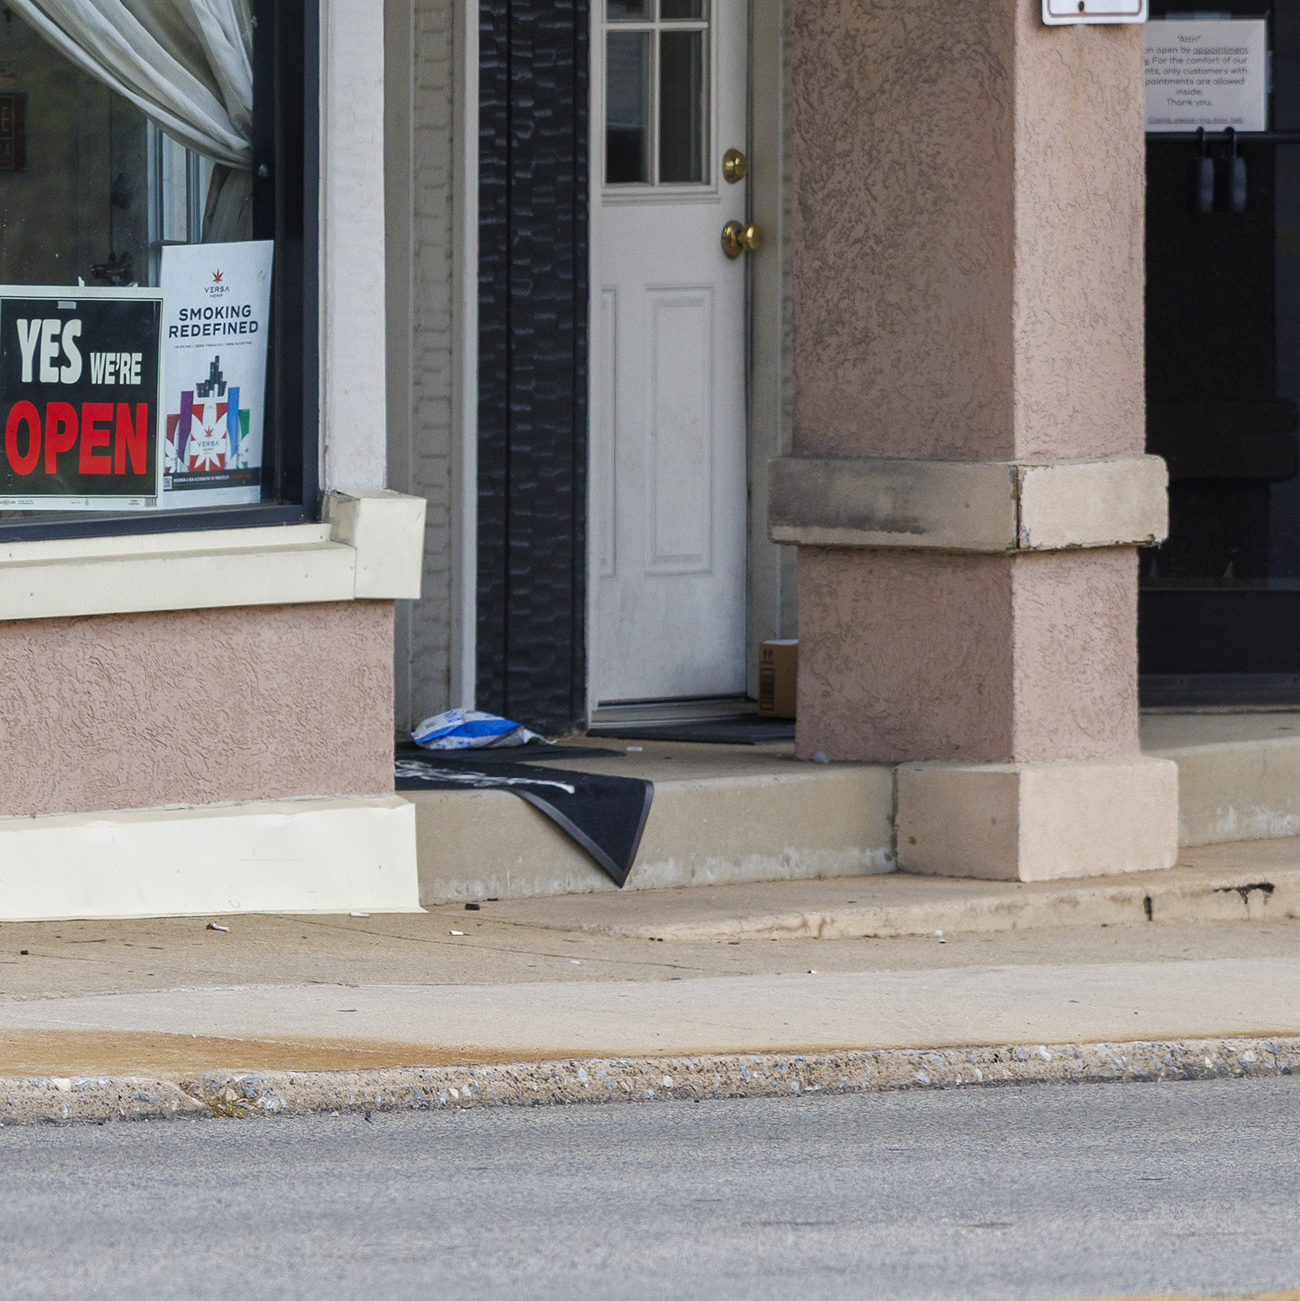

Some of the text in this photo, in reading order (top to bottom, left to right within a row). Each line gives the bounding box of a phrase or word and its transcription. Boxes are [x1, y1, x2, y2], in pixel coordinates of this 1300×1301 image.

[1181, 46, 1190, 55] by
[1193, 47, 1248, 55] appointment
[1186, 56, 1220, 64] comfort
[1223, 56, 1231, 64] of
[1163, 67, 1180, 75] only
[1145, 77, 1194, 86] pointments
[1212, 77, 1244, 85] allowed
[179, 304, 252, 322] SMOKING
[168, 320, 259, 339] REDEFINED
[16, 318, 143, 385] YES WE'RE
[5, 400, 148, 476] OPEN
